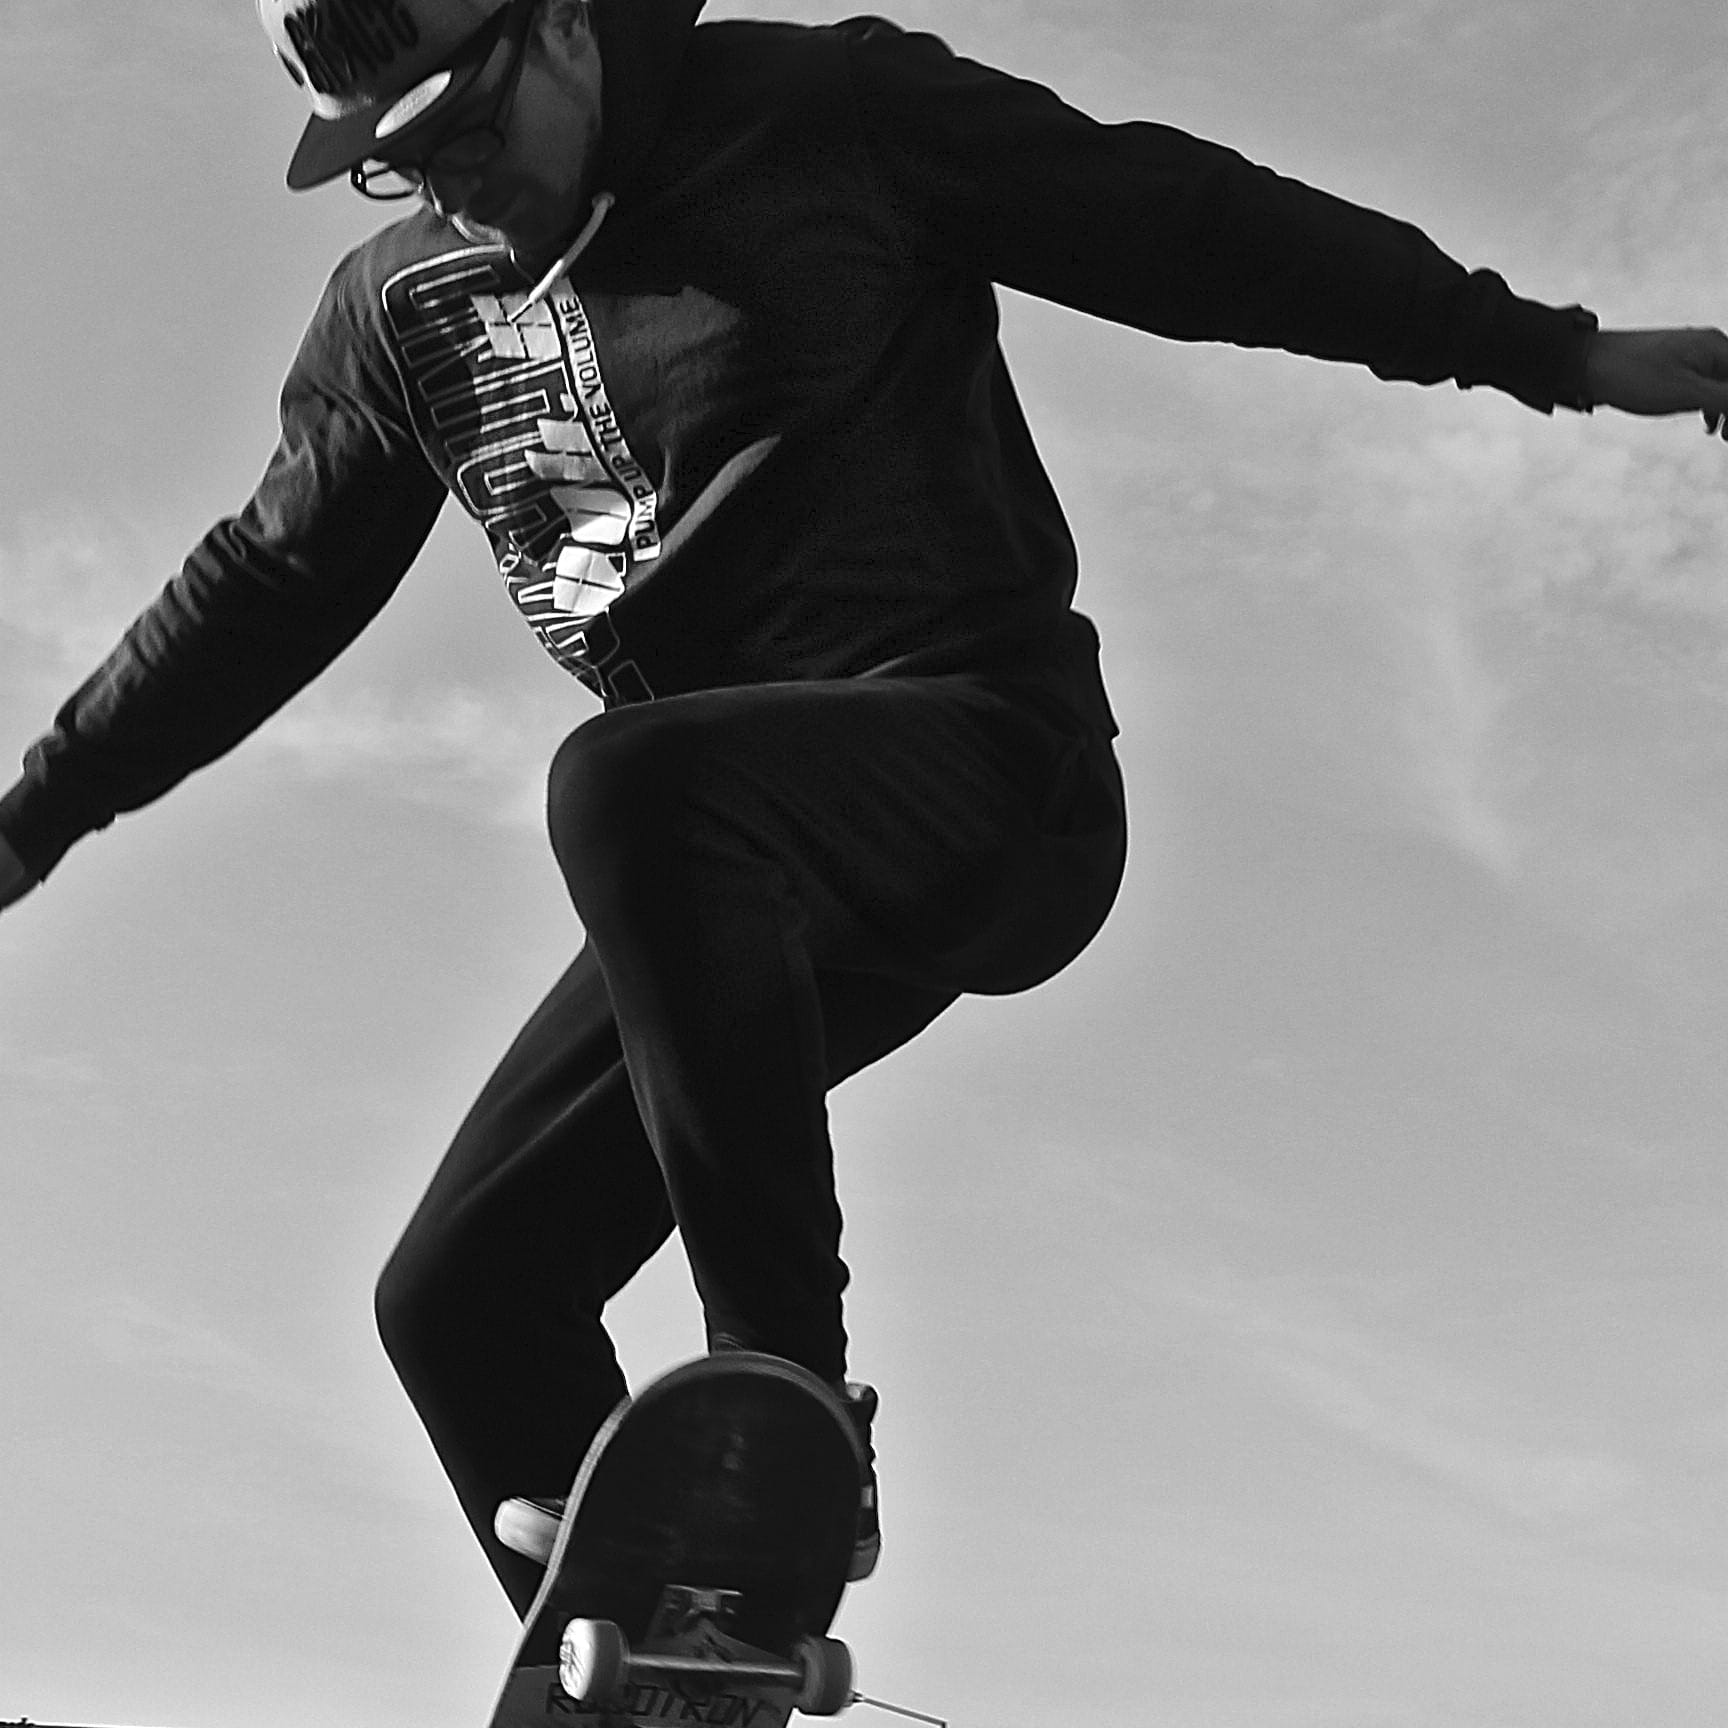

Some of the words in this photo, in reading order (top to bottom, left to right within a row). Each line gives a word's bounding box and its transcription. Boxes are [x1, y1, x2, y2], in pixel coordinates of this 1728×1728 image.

[559, 296, 604, 399] VOLUME
[589, 402, 623, 451] THE
[612, 454, 642, 482] UP
[633, 484, 660, 550] PUMP
